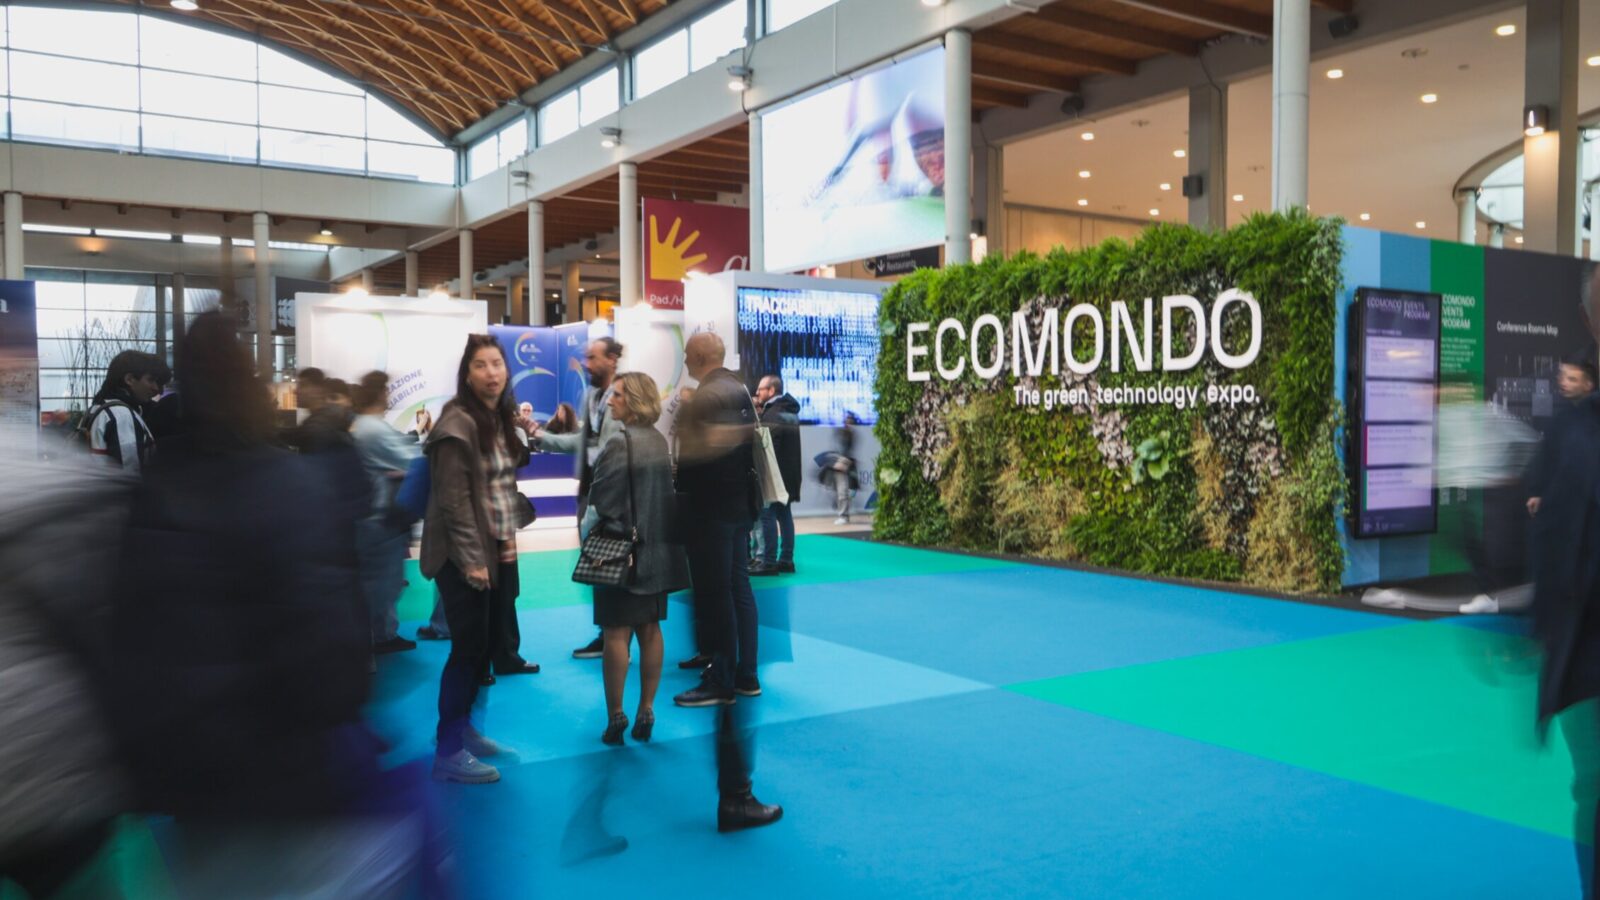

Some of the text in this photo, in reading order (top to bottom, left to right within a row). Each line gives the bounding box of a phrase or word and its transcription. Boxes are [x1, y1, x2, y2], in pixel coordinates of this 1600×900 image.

[650, 293, 684, 306] Pad./H
[1442, 294, 1475, 308] COMONDO
[1442, 306, 1464, 318] VENTS
[906, 287, 1263, 382] ECOMONDO
[1497, 320, 1558, 338] Conference Rooms Map
[1013, 382, 1260, 411] The green technology expo.
